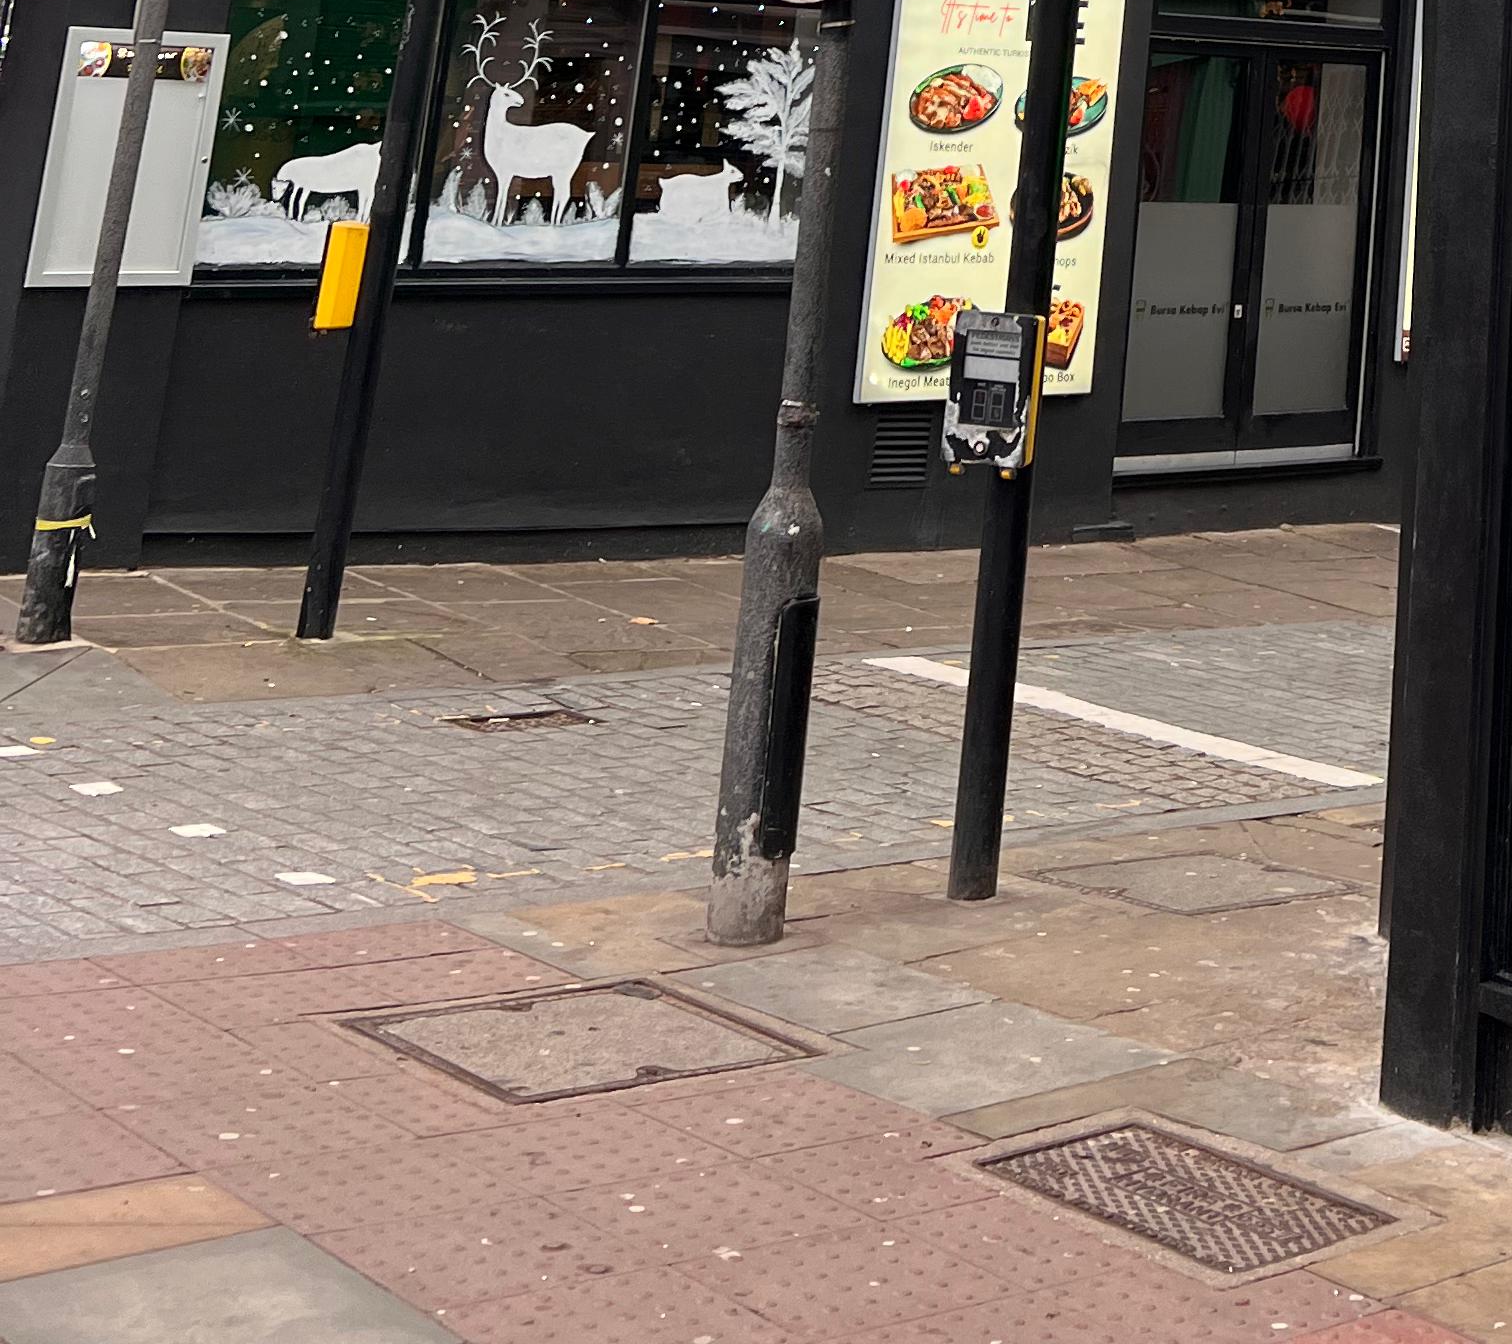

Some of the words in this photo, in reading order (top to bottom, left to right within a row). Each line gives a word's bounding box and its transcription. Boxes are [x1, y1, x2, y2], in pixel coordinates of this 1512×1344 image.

[965, 0, 998, 35] time
[999, 2, 1020, 37] to
[958, 47, 1000, 57] AUTHENTIC
[1003, 49, 1031, 58] TURKIS
[929, 141, 973, 153] Iskender
[885, 253, 915, 264] Mixed
[918, 253, 960, 264] Istanbul
[963, 254, 994, 265] Kebab
[888, 376, 920, 390] Inegol
[1057, 371, 1074, 383] Box
